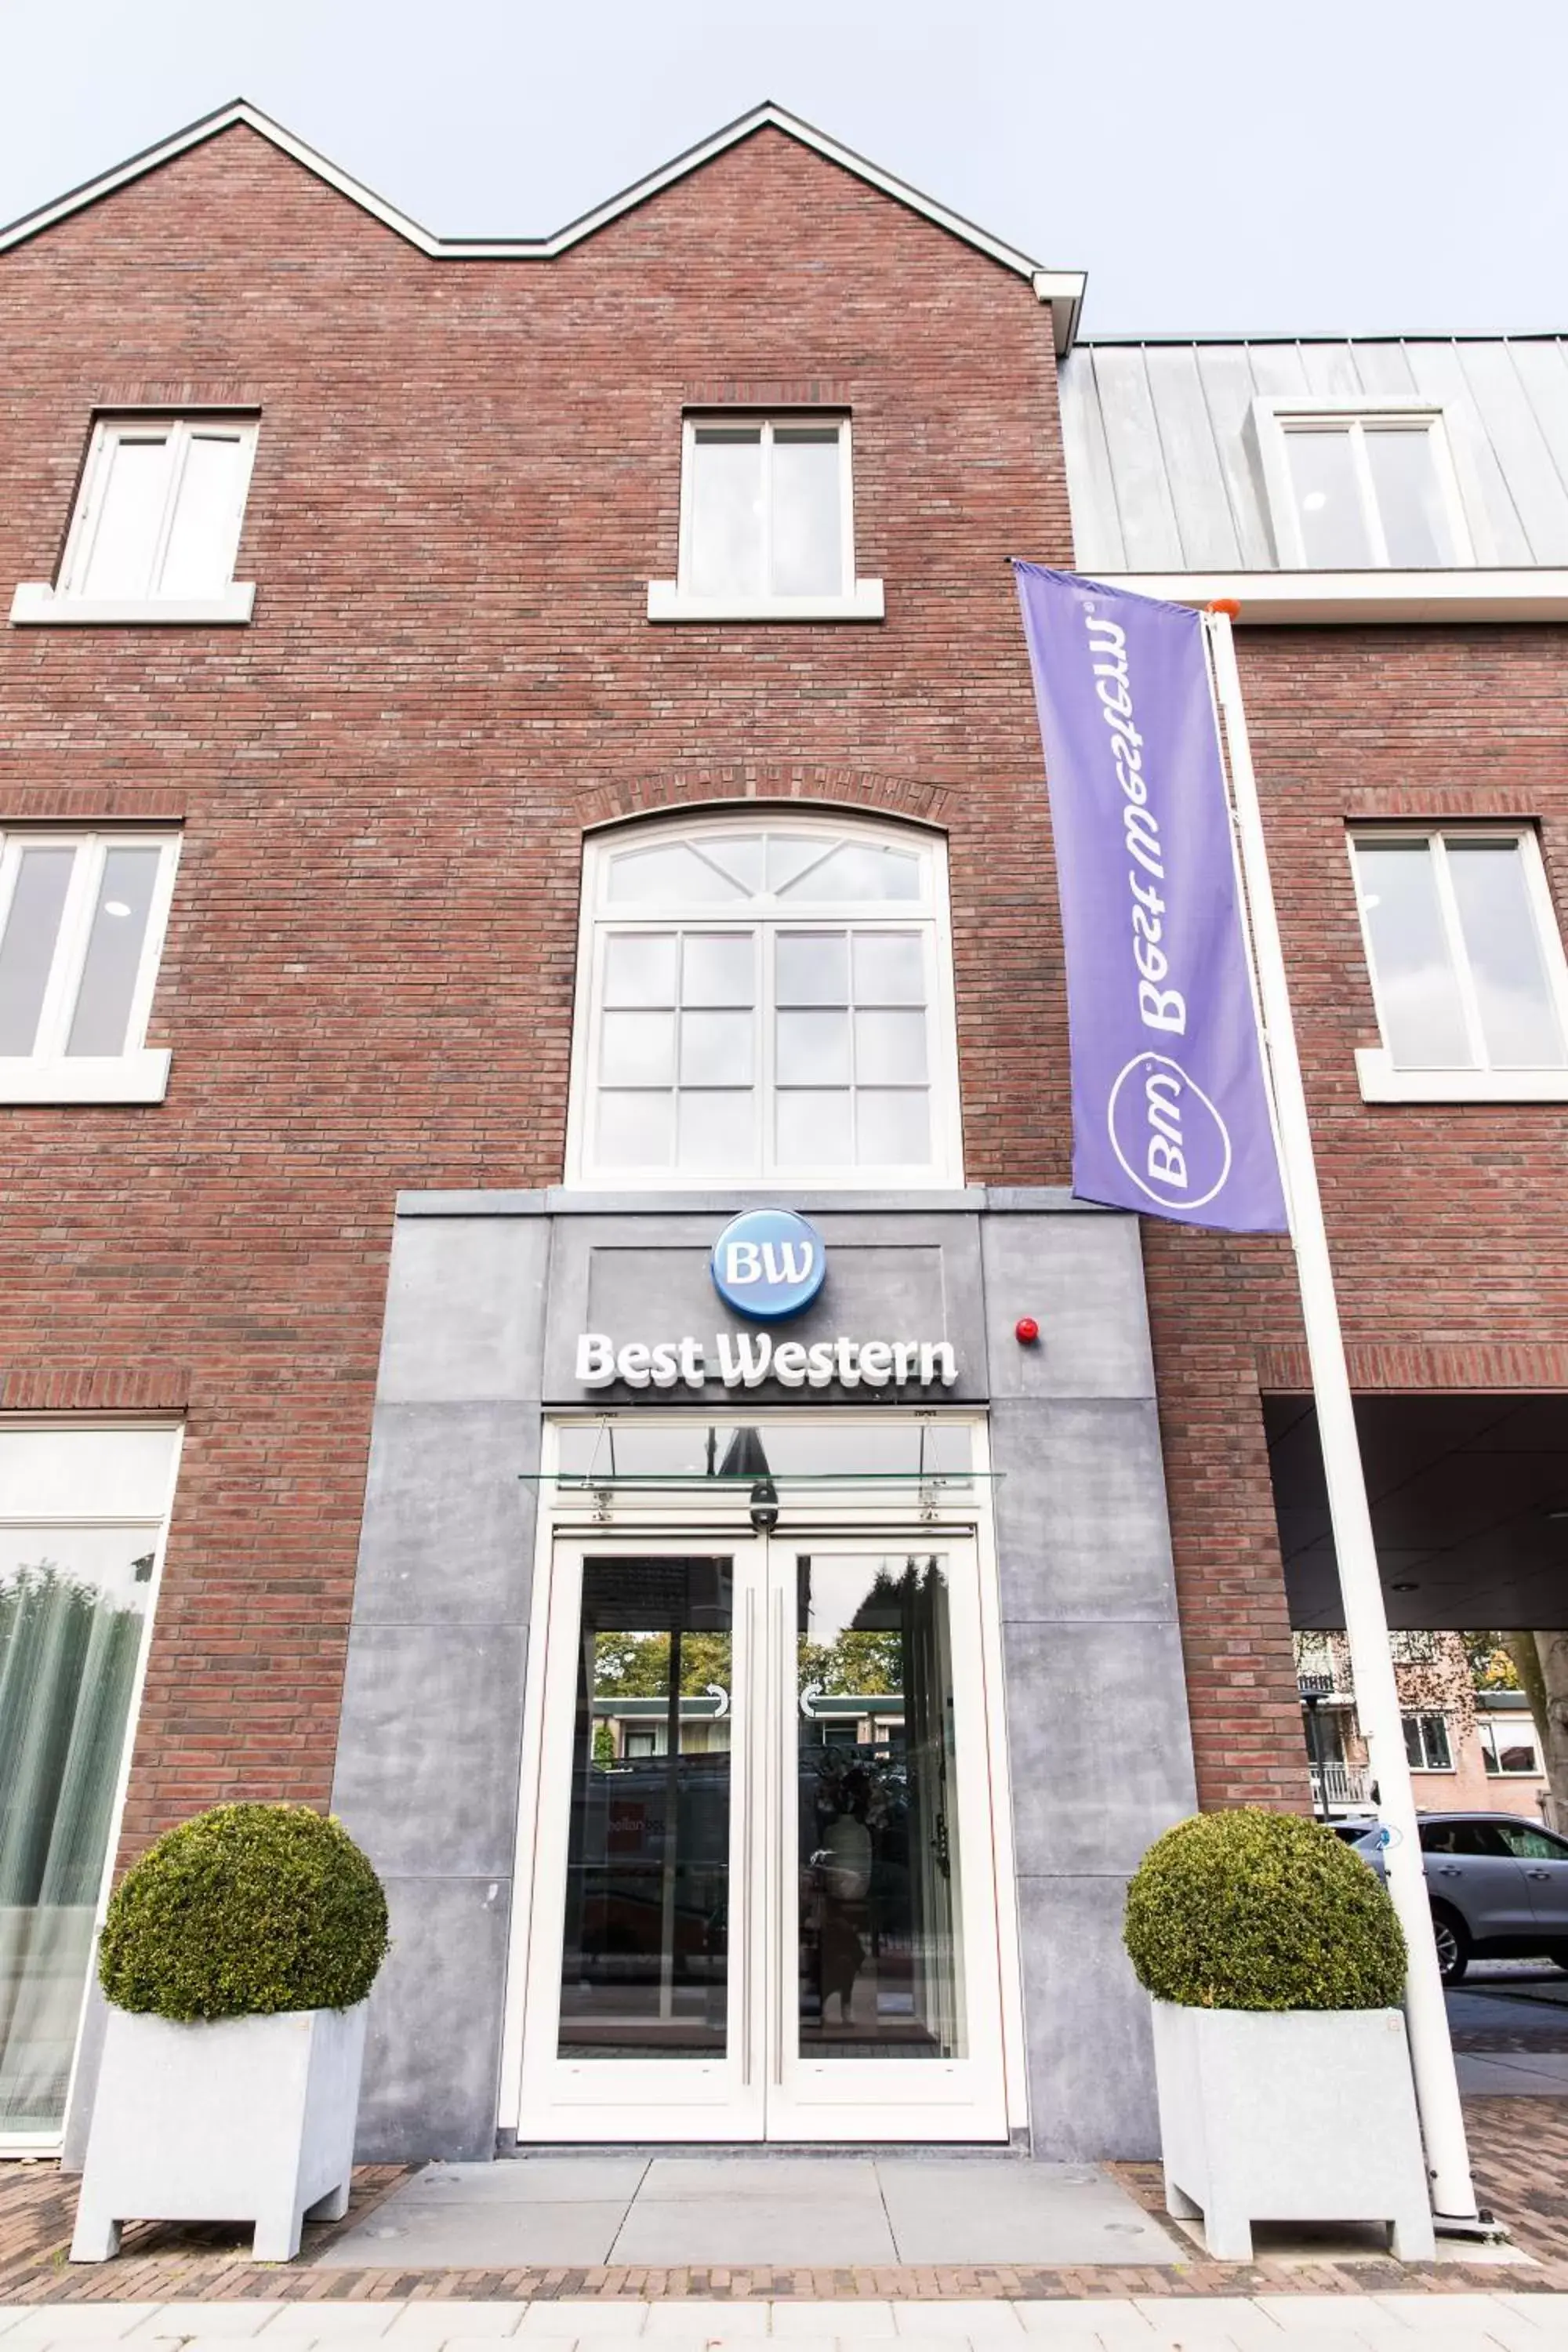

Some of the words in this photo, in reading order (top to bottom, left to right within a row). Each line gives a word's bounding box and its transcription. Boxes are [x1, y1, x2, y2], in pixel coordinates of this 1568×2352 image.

[725, 1241, 814, 1284] BW
[575, 1333, 704, 1388] Best
[716, 1333, 958, 1388] Western
